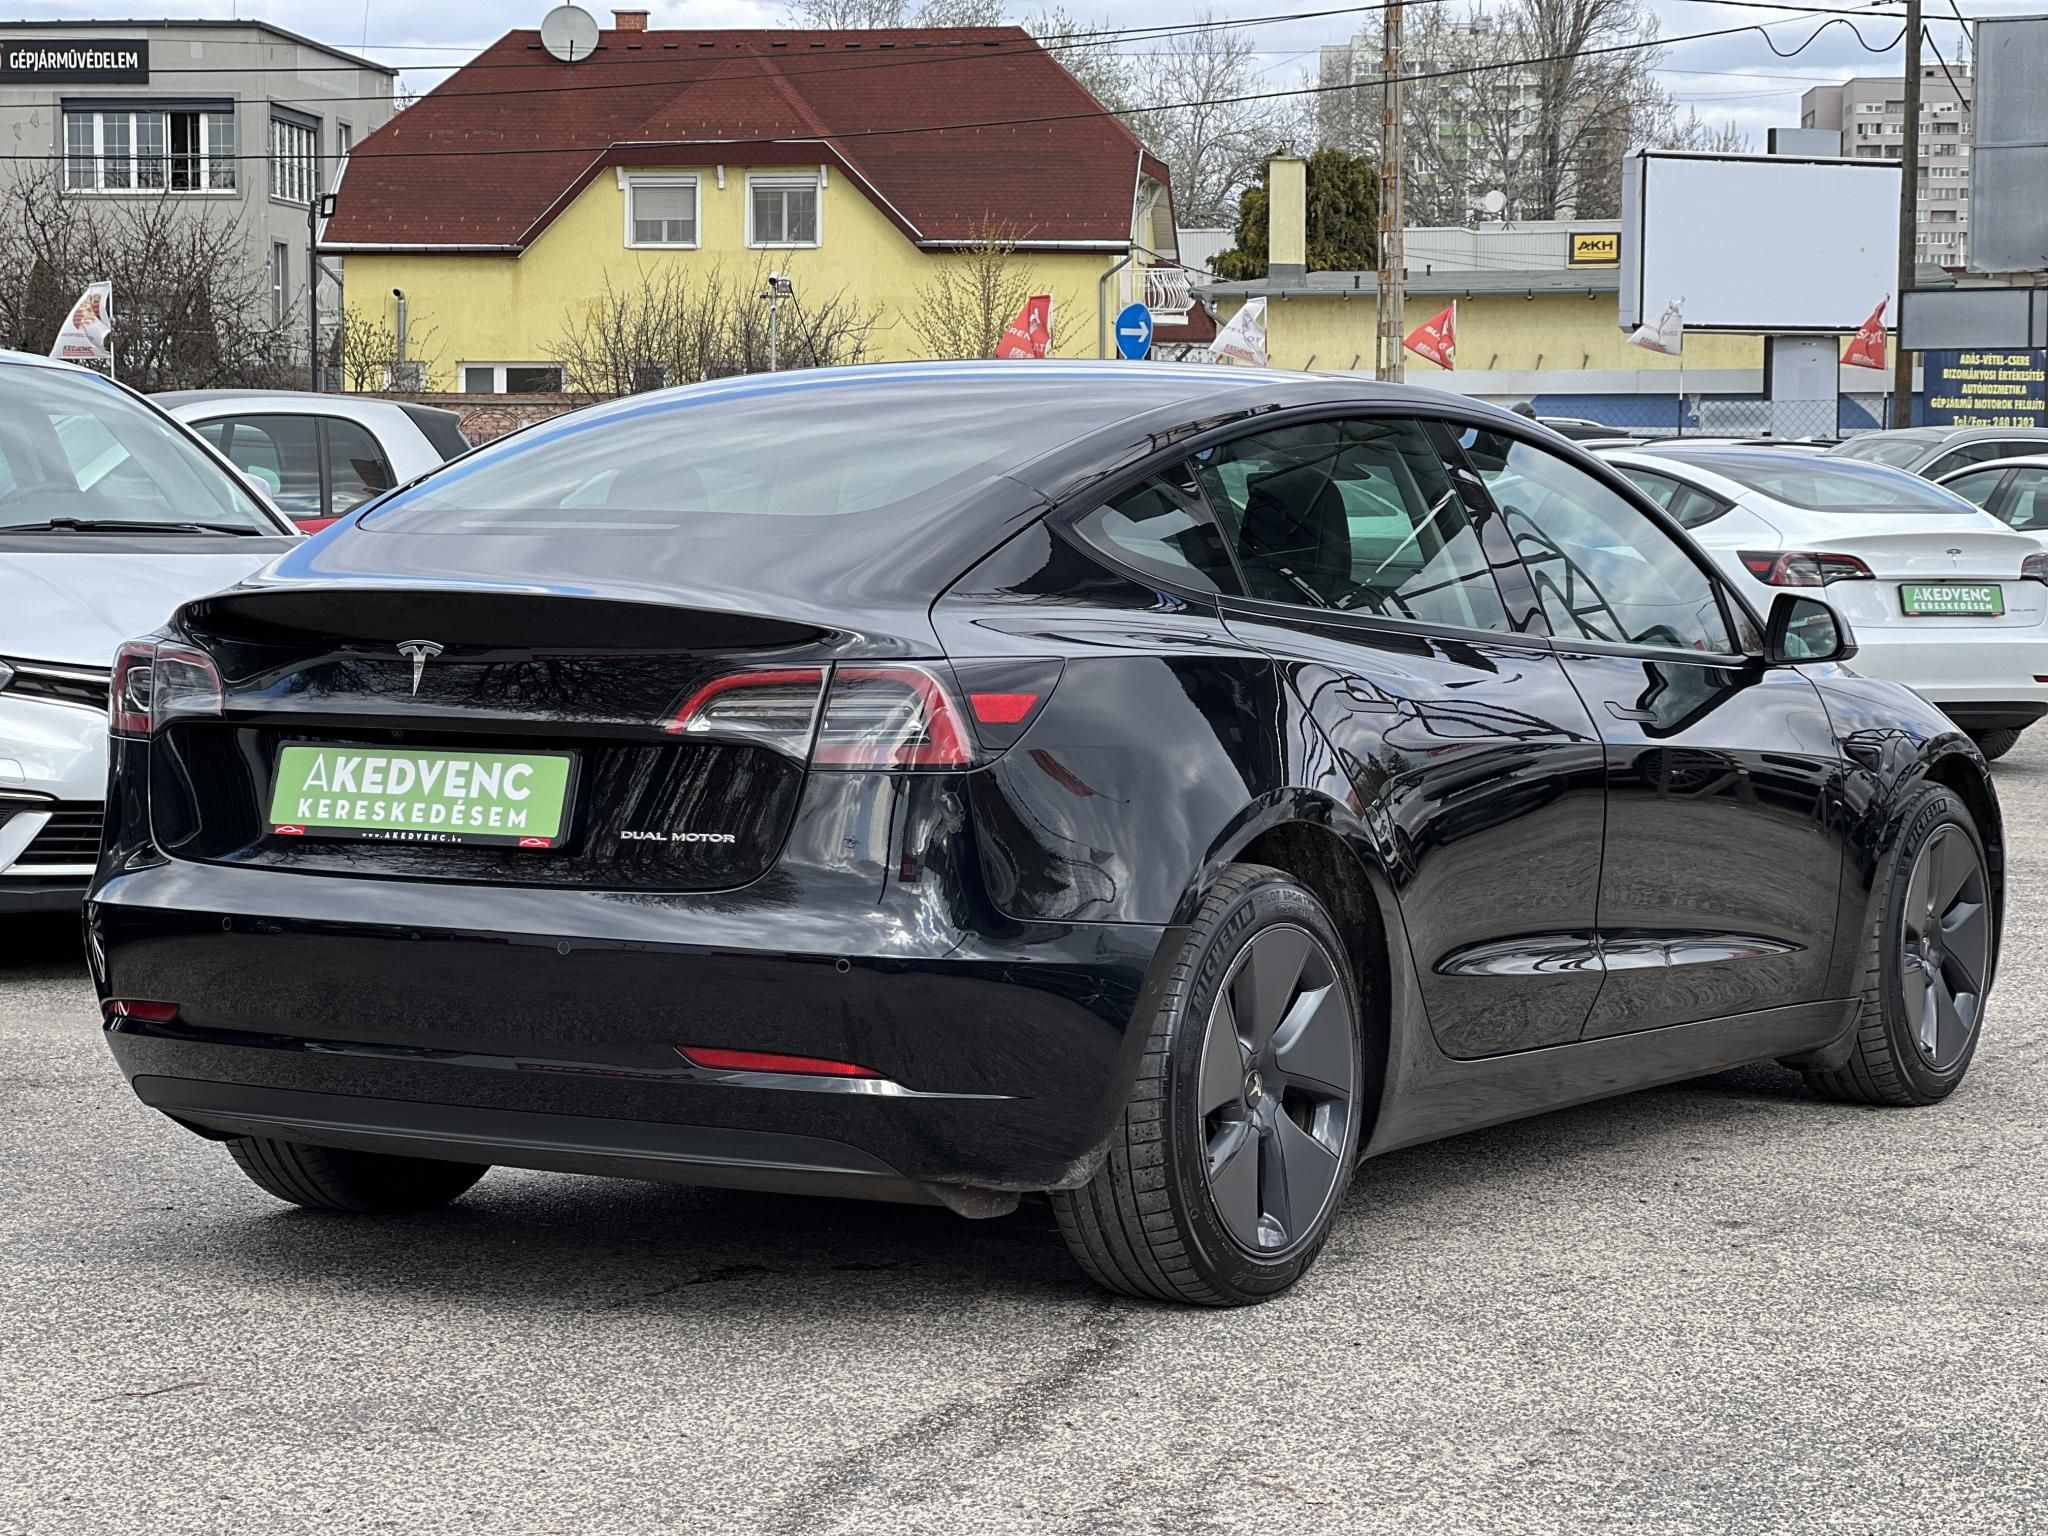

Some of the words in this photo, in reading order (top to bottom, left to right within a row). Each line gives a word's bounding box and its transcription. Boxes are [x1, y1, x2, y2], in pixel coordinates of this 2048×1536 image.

[10, 49, 138, 71] GÉPJÁRMŰVÉDELEM
[1577, 240, 1613, 251] AKH
[1960, 353, 2030, 366] ADÁS-VÉTEL-CSERE
[1943, 367, 1996, 379] BIZOMÁNYOSI
[1999, 368, 2045, 381] ÉRTÉKESÍTÉS
[1961, 382, 2027, 394] AUTÓKOZMETIKA
[1931, 396, 1973, 408] GÉPJÁRMŰ
[1974, 399, 2013, 410] MOTOROK
[297, 798, 528, 828] KERESKEDÉSEM
[1907, 798, 1947, 852] MICHELIN
[620, 831, 667, 840] DUAL
[671, 833, 735, 843] MOTOR
[1190, 900, 1255, 1013] MICHELIN
